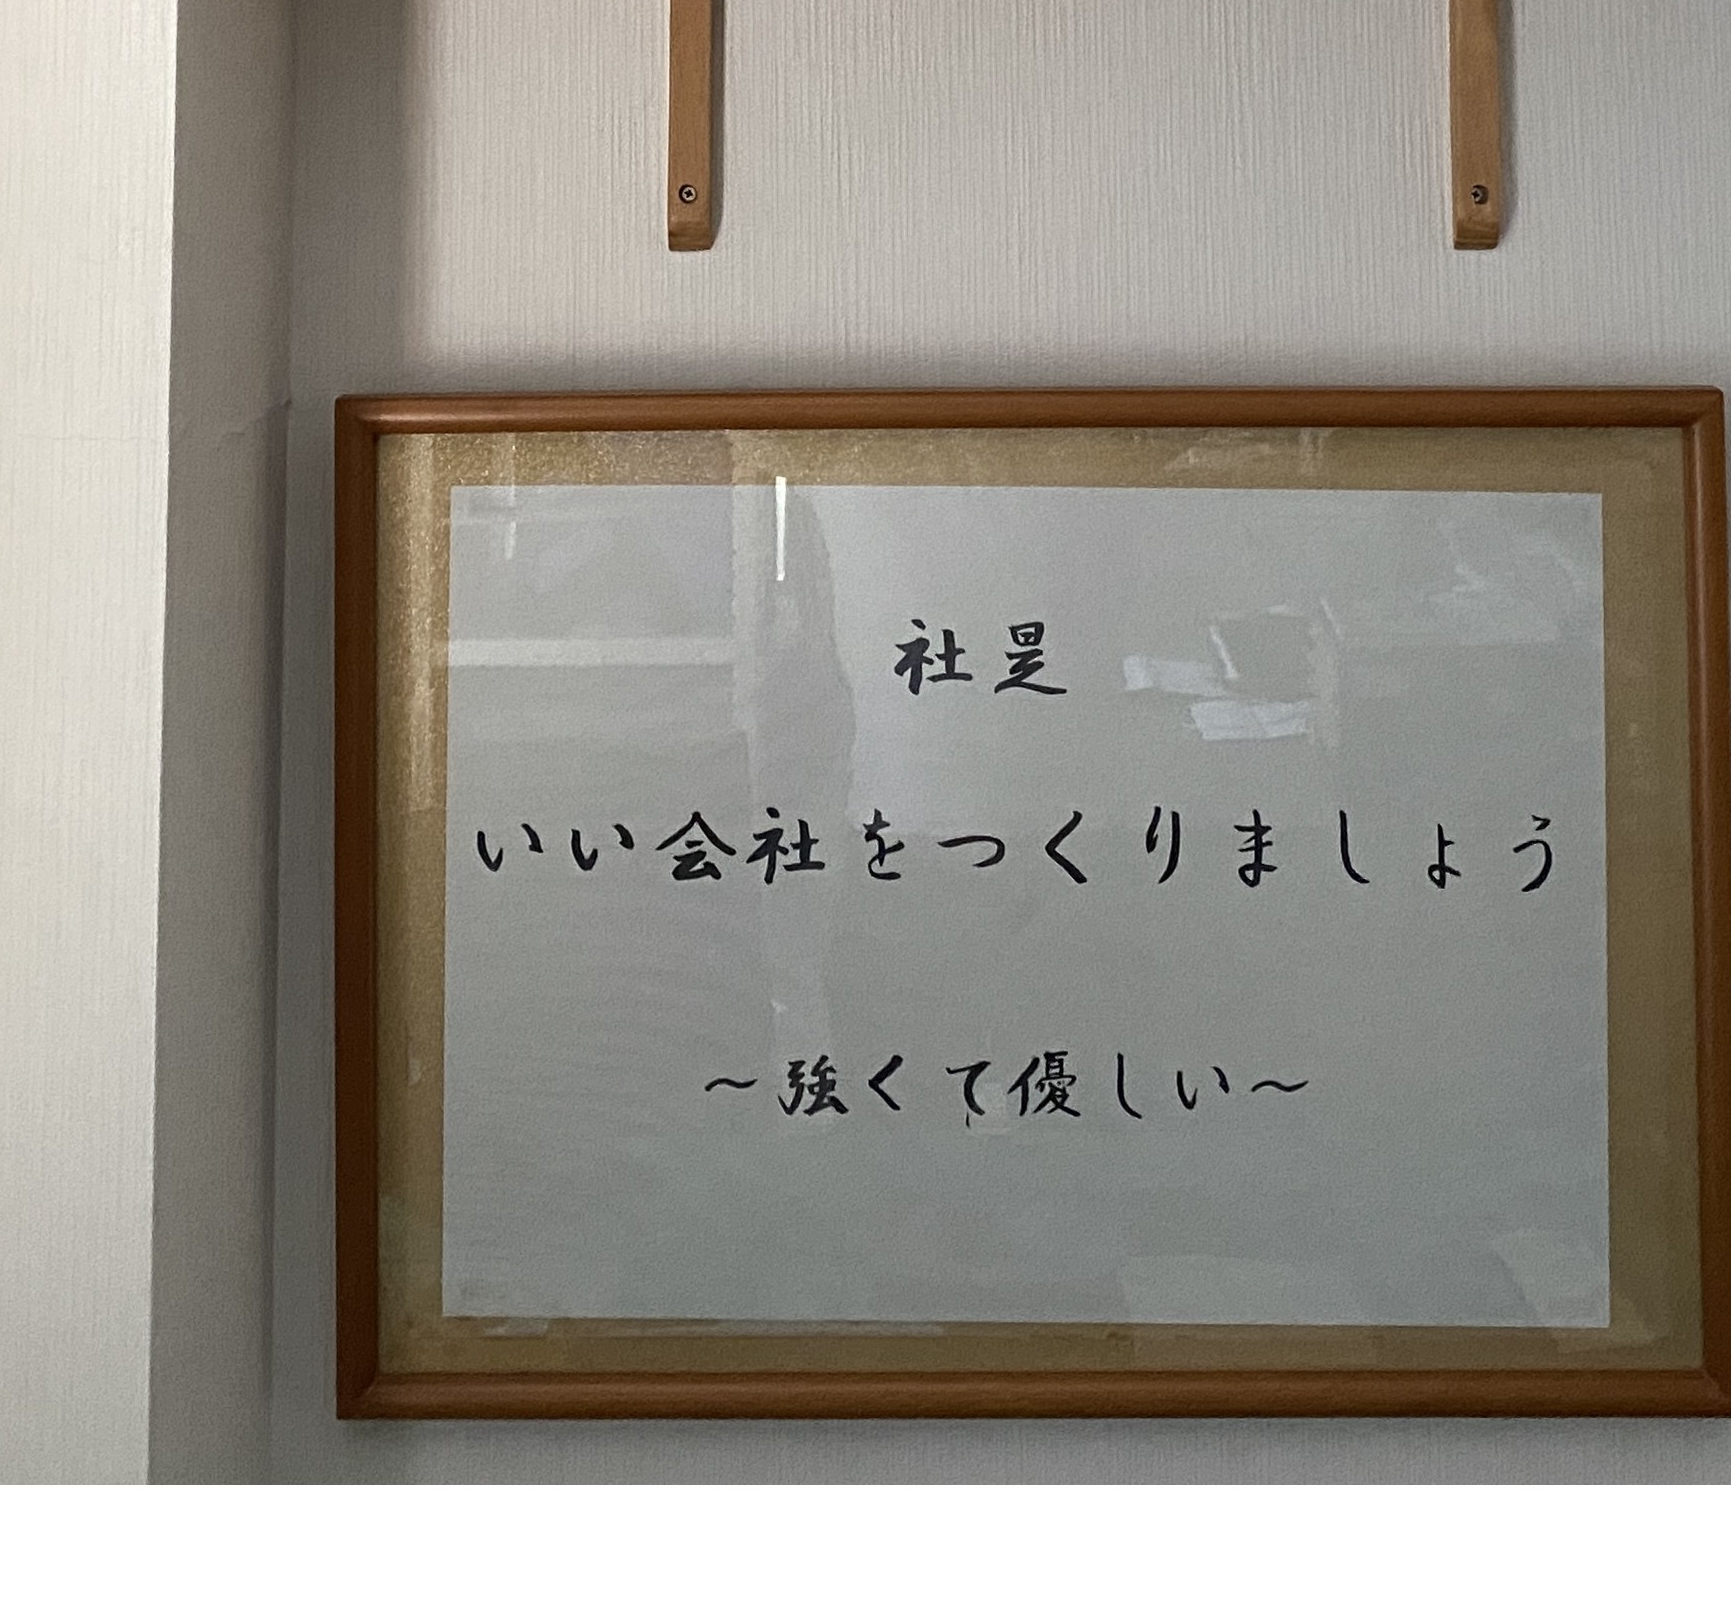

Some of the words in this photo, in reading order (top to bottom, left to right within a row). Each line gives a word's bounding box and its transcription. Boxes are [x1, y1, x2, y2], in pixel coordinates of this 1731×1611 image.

[894, 618, 1068, 696] 社是
[475, 805, 1554, 893] いい会社をつくりましょう
